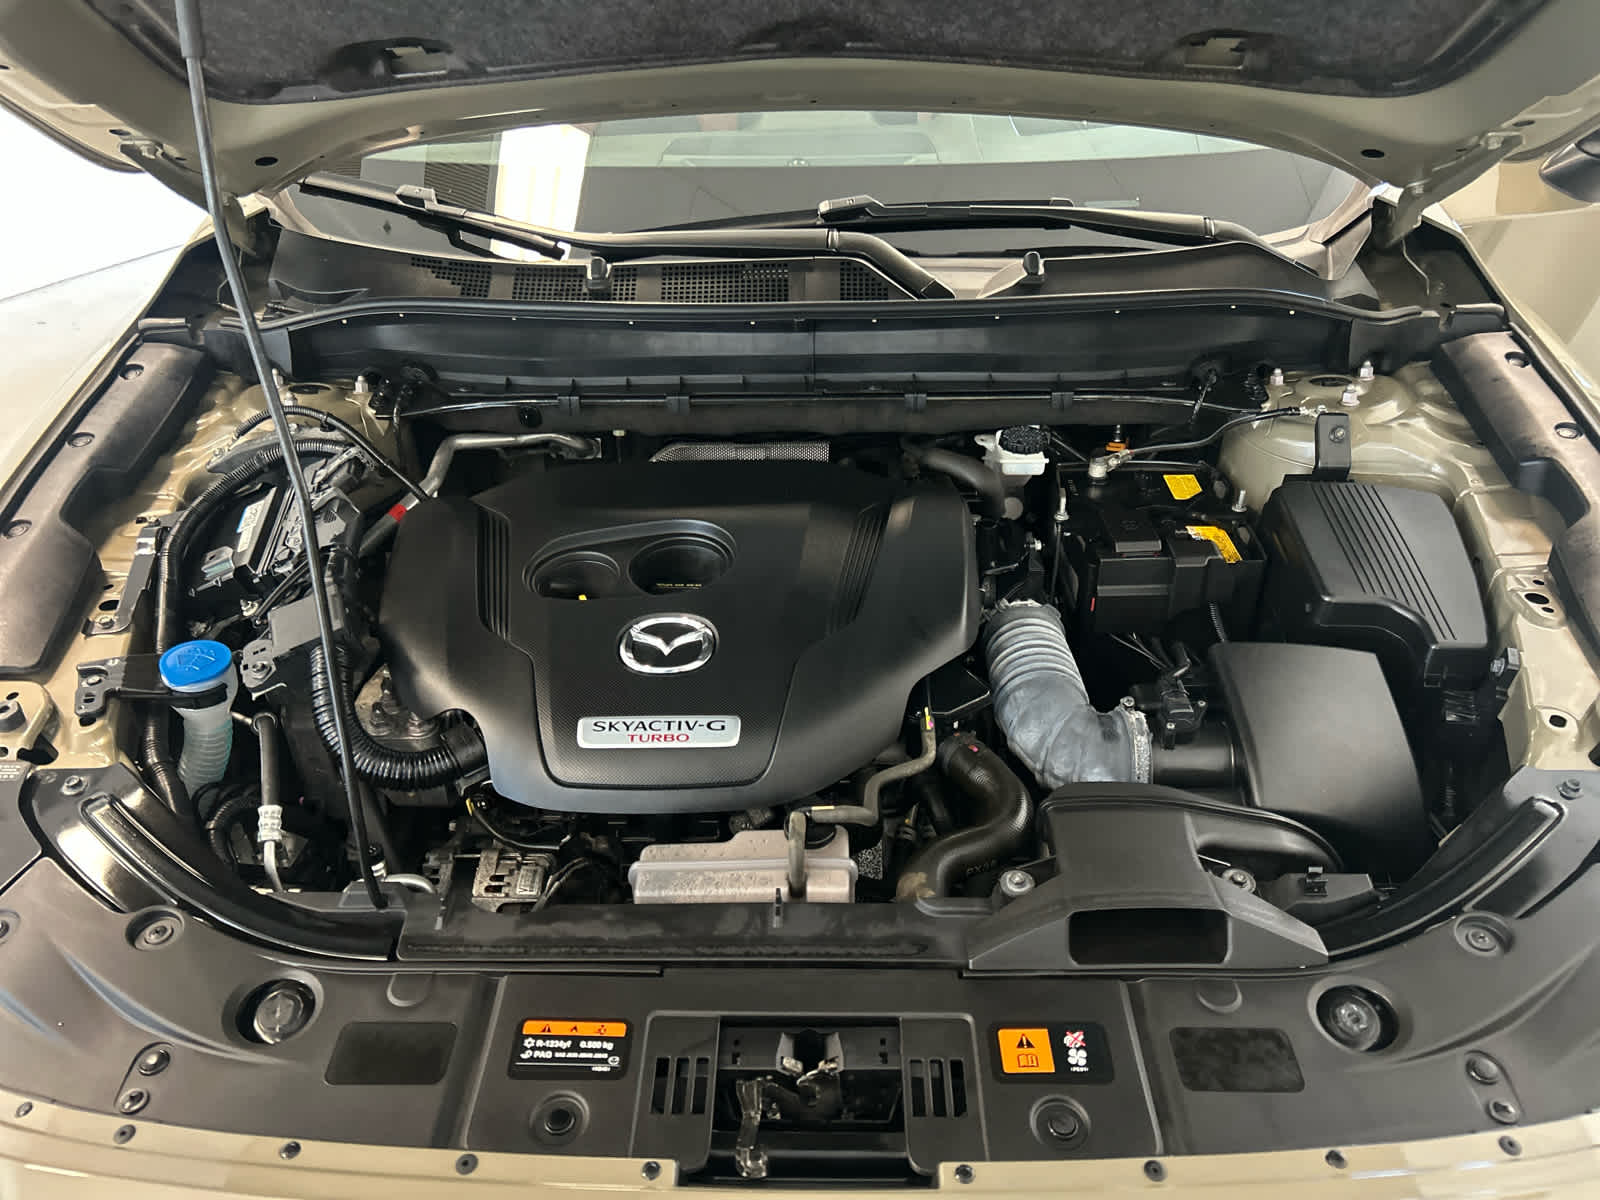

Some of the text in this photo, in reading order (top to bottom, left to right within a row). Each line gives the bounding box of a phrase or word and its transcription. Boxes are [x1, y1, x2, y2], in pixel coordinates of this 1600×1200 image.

[592, 719, 727, 732] SKYACTIV-G
[627, 733, 690, 743] TURBO
[535, 1040, 572, 1049] R-1234yf
[602, 1041, 614, 1050] kg
